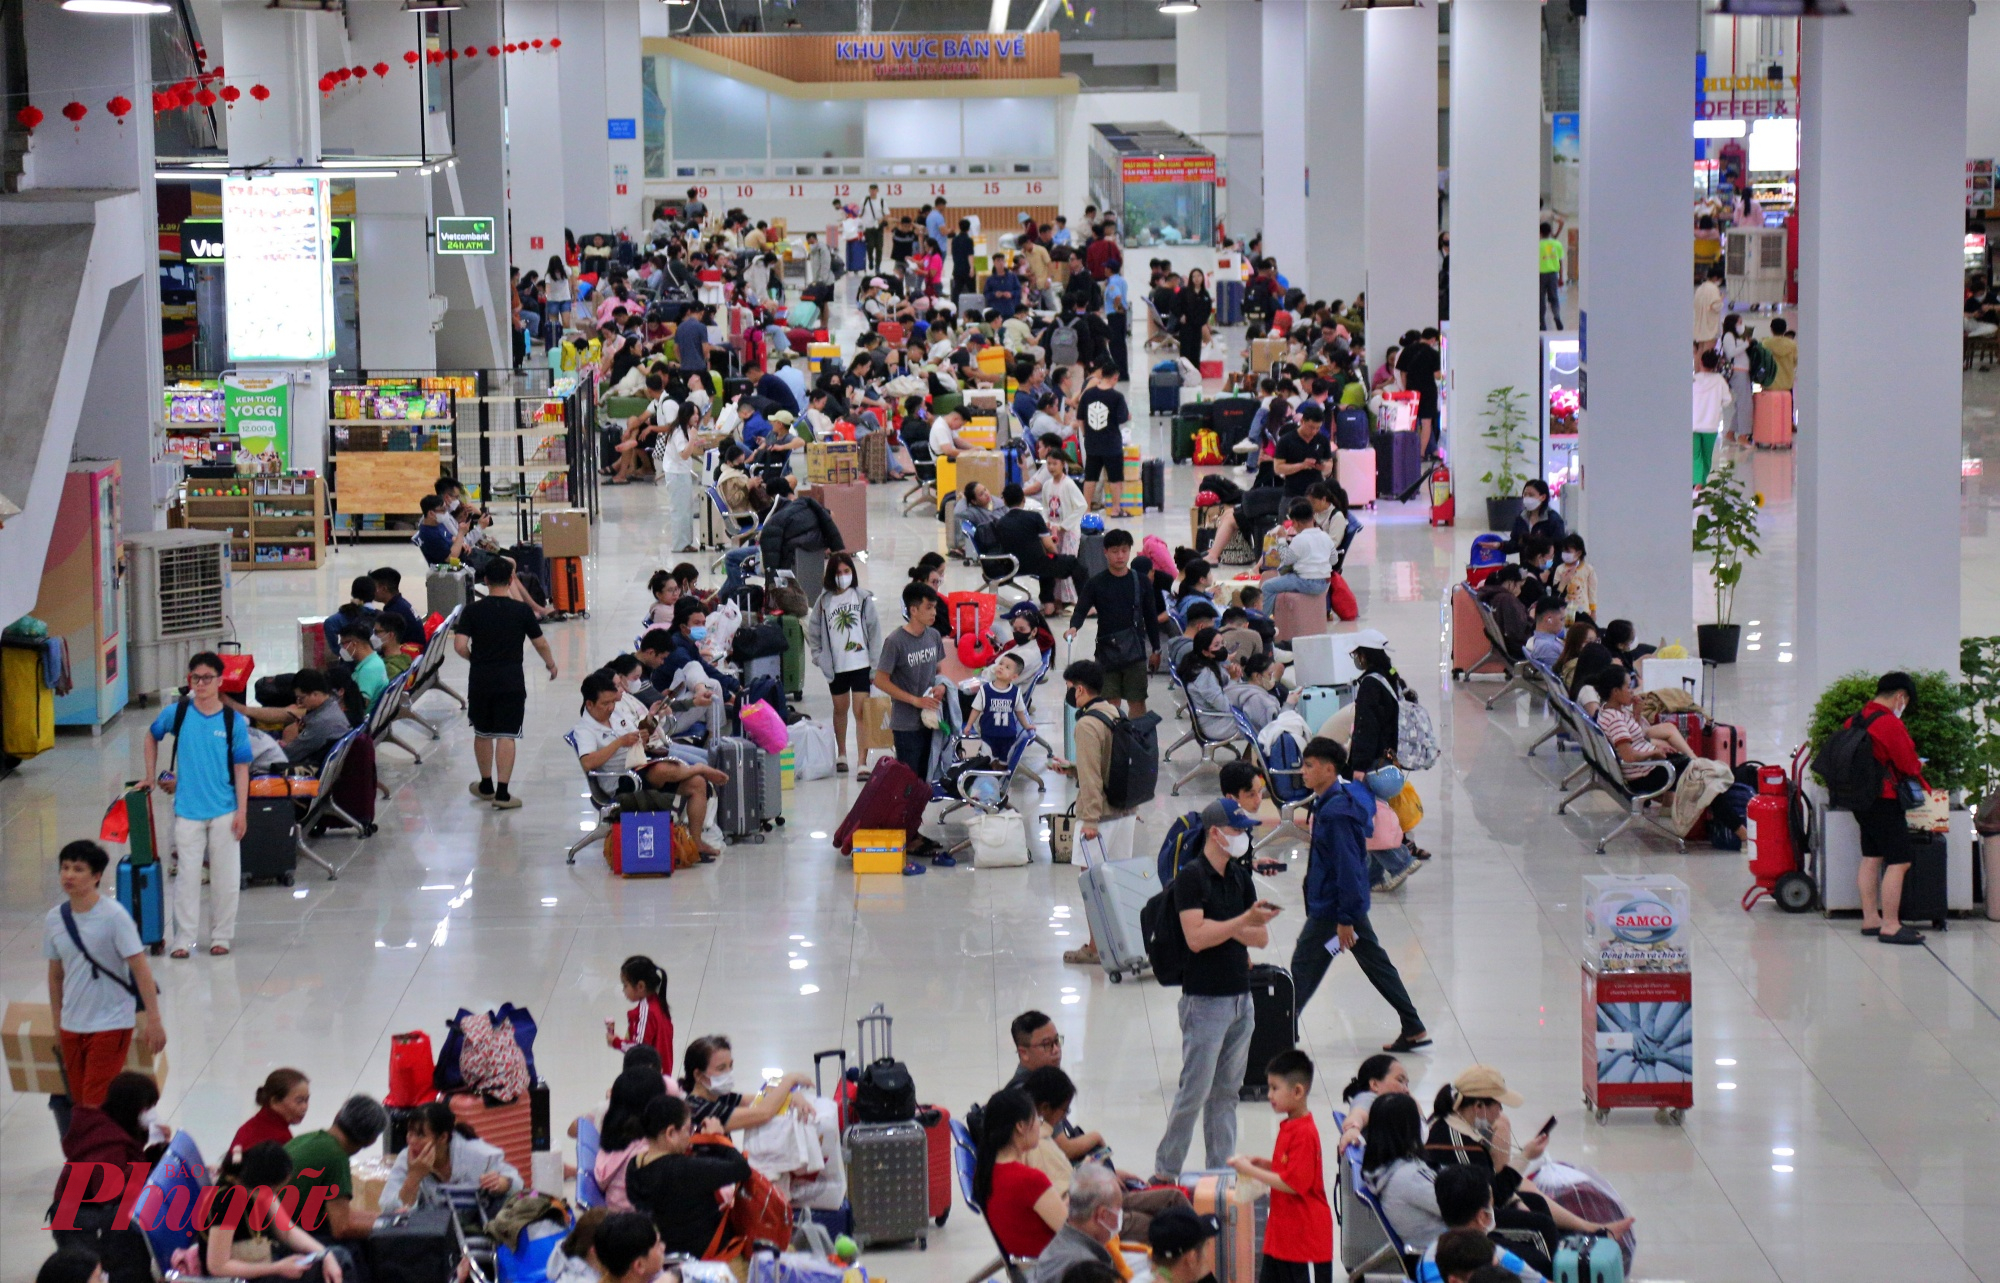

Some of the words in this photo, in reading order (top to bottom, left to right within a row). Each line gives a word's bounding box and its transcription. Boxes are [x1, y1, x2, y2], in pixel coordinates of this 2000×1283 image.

[836, 41, 884, 60] KHU
[891, 37, 938, 62] VỰC
[943, 35, 990, 58] BÁN
[995, 34, 1026, 57] VÉ
[1775, 99, 1788, 115] &
[737, 185, 753, 197] 10
[789, 185, 804, 196] 11
[834, 185, 850, 196] 12
[886, 184, 902, 195] 13
[930, 184, 946, 195] 14
[984, 182, 1000, 194] 15
[1026, 182, 1042, 194] 16
[441, 232, 490, 241] Vietcombank
[447, 241, 464, 249] 24h
[466, 241, 484, 249] ATM
[230, 405, 282, 417] YOGGI
[994, 712, 1008, 726] 11
[1616, 915, 1672, 927] SAMCO
